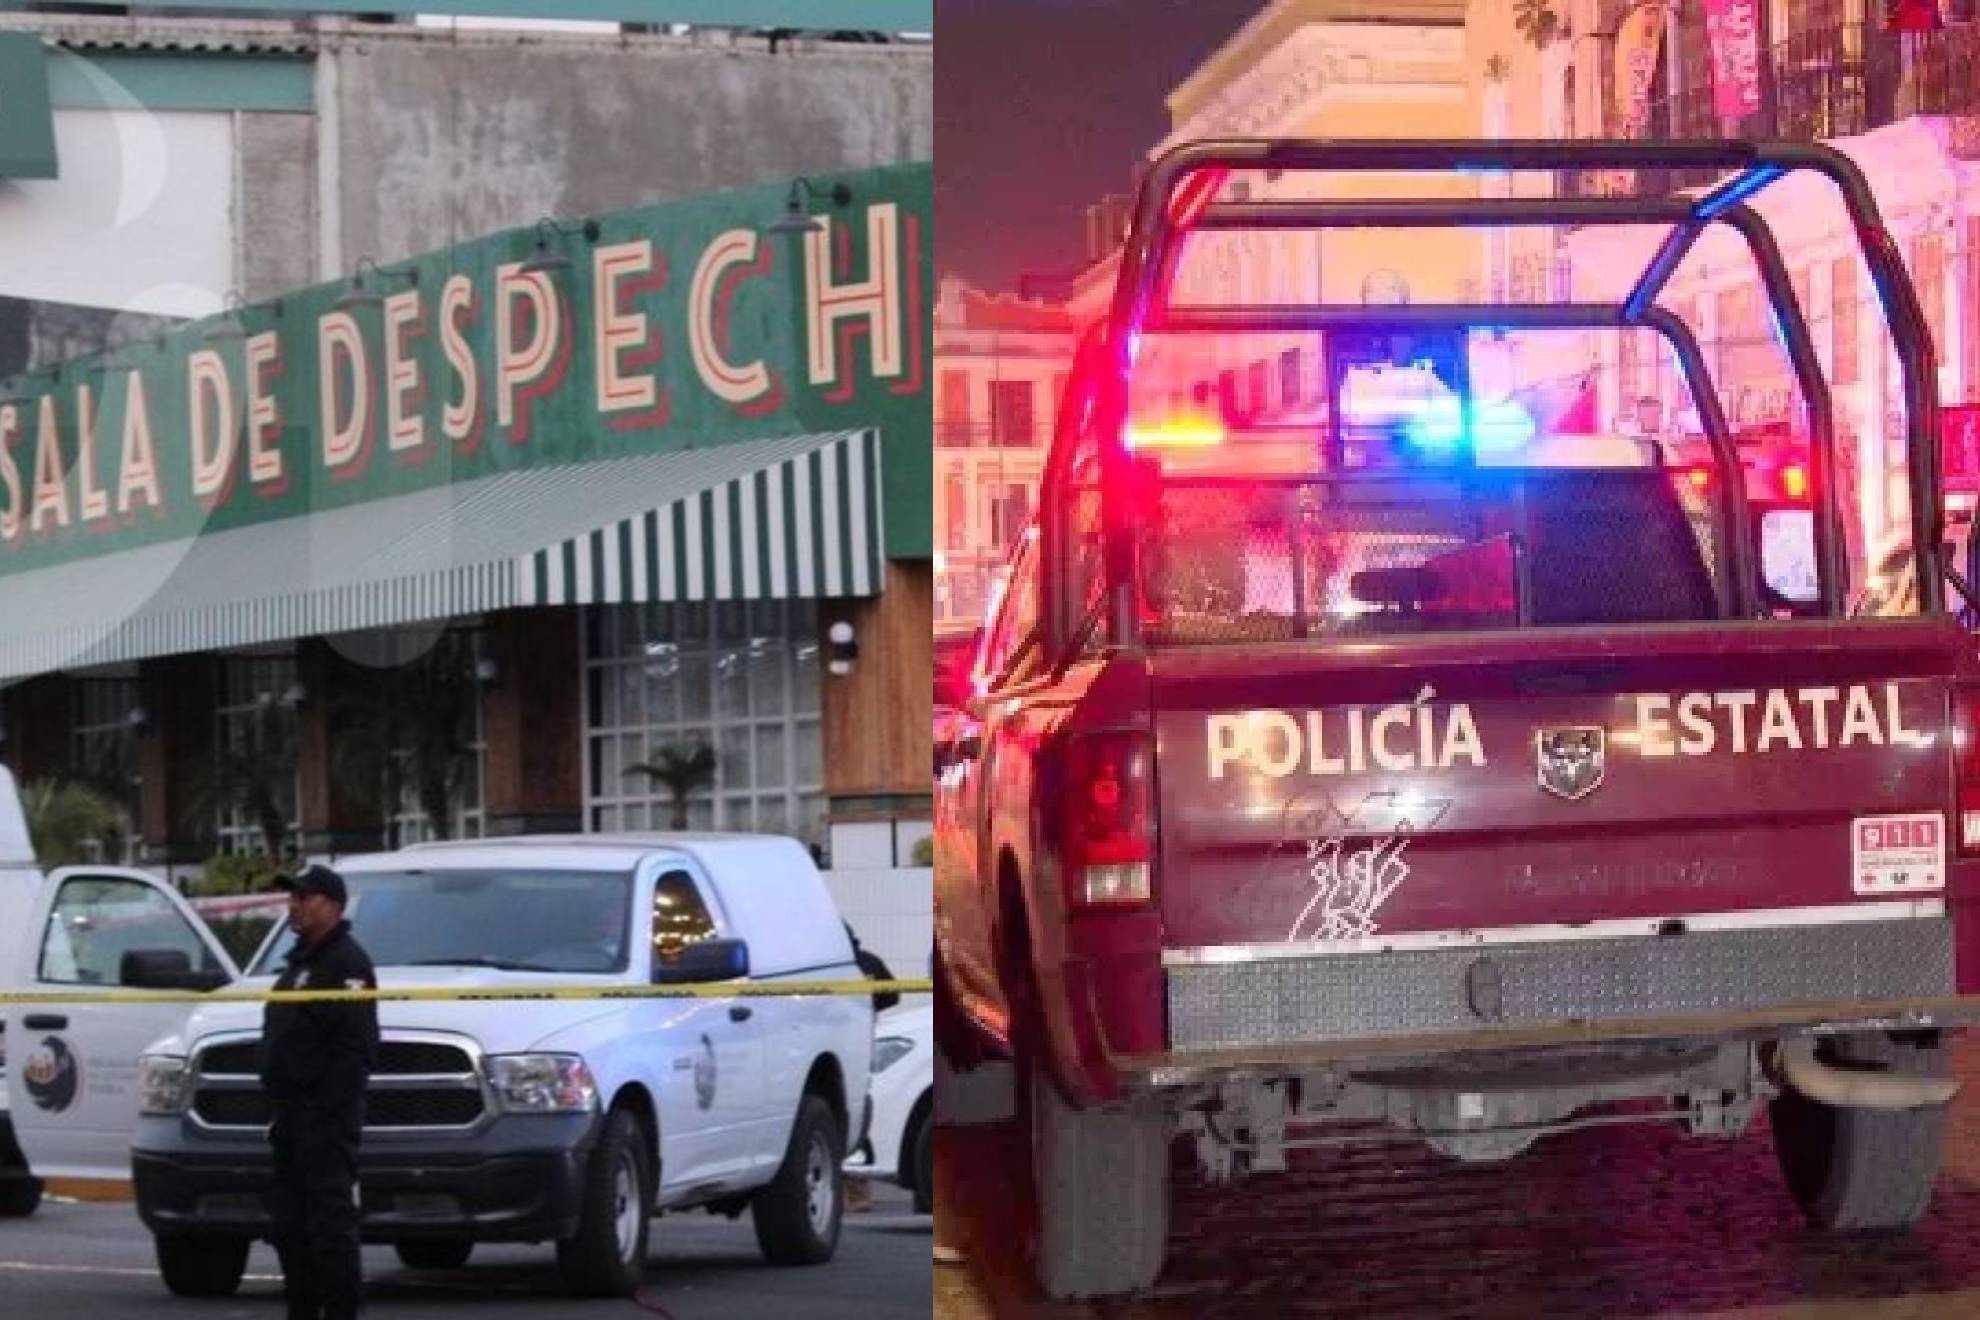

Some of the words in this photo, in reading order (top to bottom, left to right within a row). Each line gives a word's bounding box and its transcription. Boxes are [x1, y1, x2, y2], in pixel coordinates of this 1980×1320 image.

[0, 369, 164, 542] SALA
[187, 331, 286, 499] DE
[318, 202, 912, 474] DESPECH
[1206, 684, 1488, 778] POLICÍA
[1635, 681, 1928, 757] ESTATAL
[1862, 823, 1934, 849] 911
